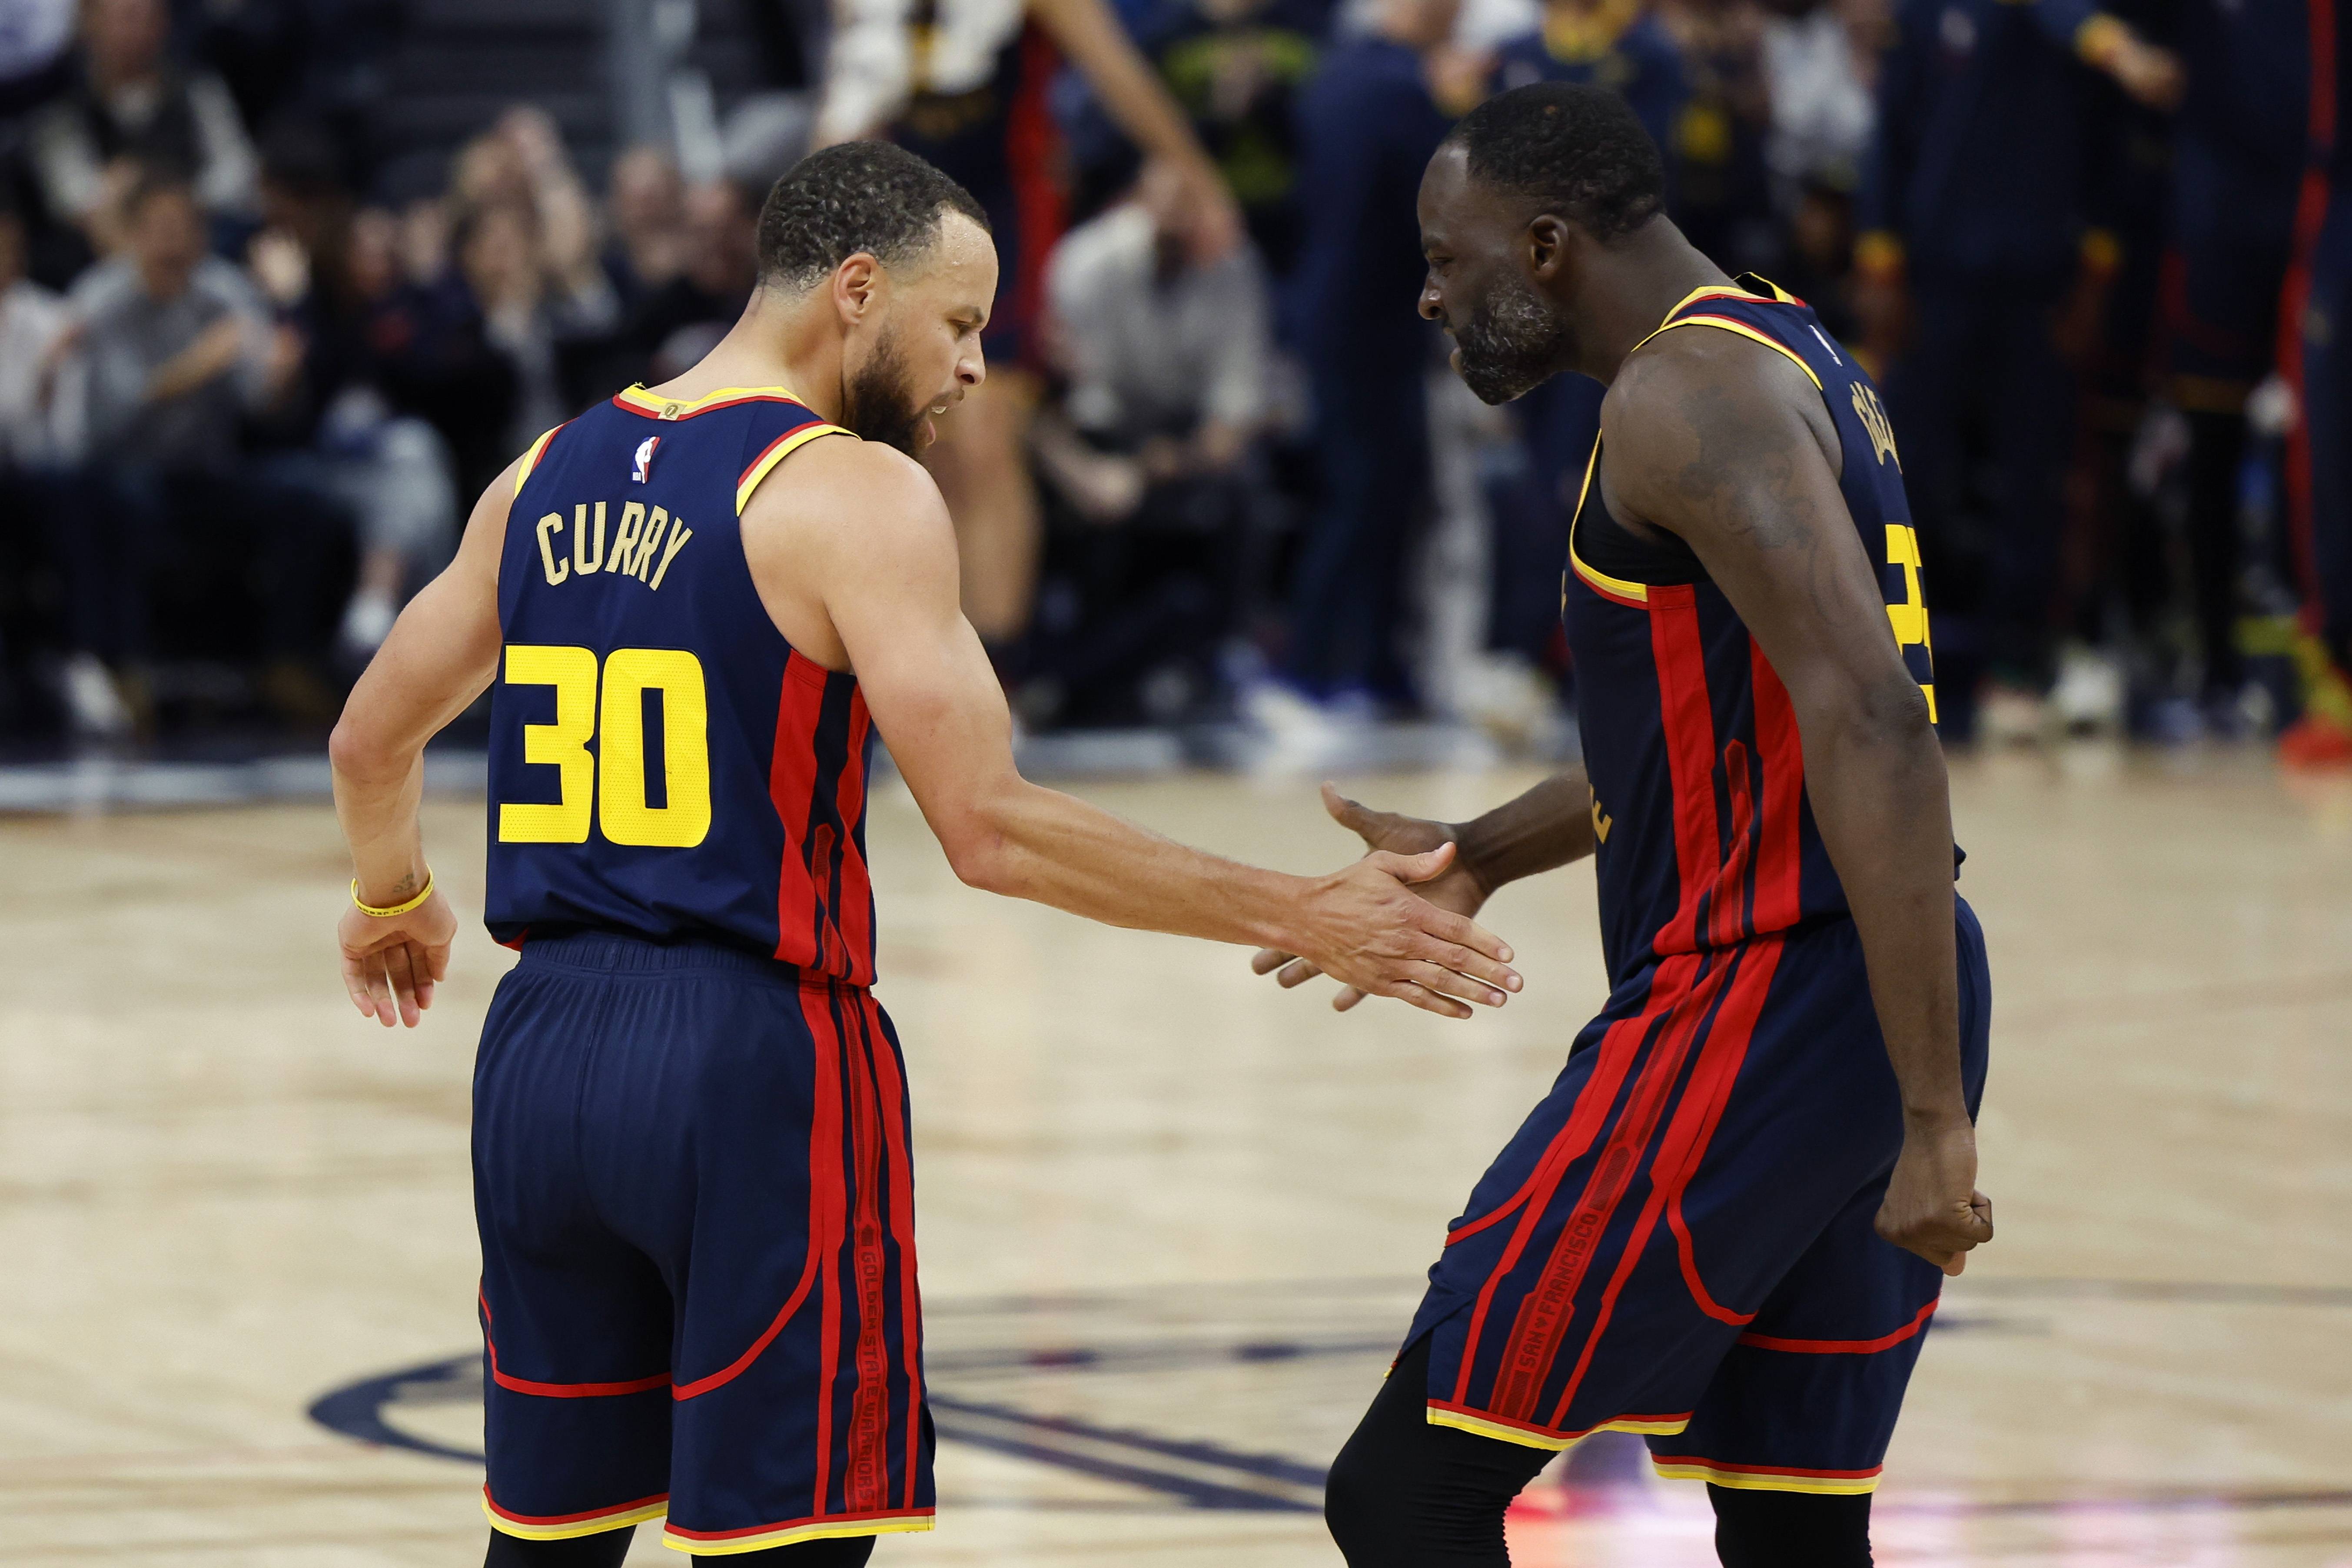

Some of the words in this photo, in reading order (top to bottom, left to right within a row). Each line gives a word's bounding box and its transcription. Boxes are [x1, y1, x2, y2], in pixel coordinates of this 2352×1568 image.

[536, 501, 693, 591] CURRY
[498, 644, 712, 847] 30
[861, 1251, 878, 1330] GOLDEN
[1518, 1330, 1546, 1368] SAN
[1538, 1213, 1599, 1316] FRANCISCO
[863, 1335, 881, 1399] STATE
[857, 1402, 875, 1500] WARRIORS
